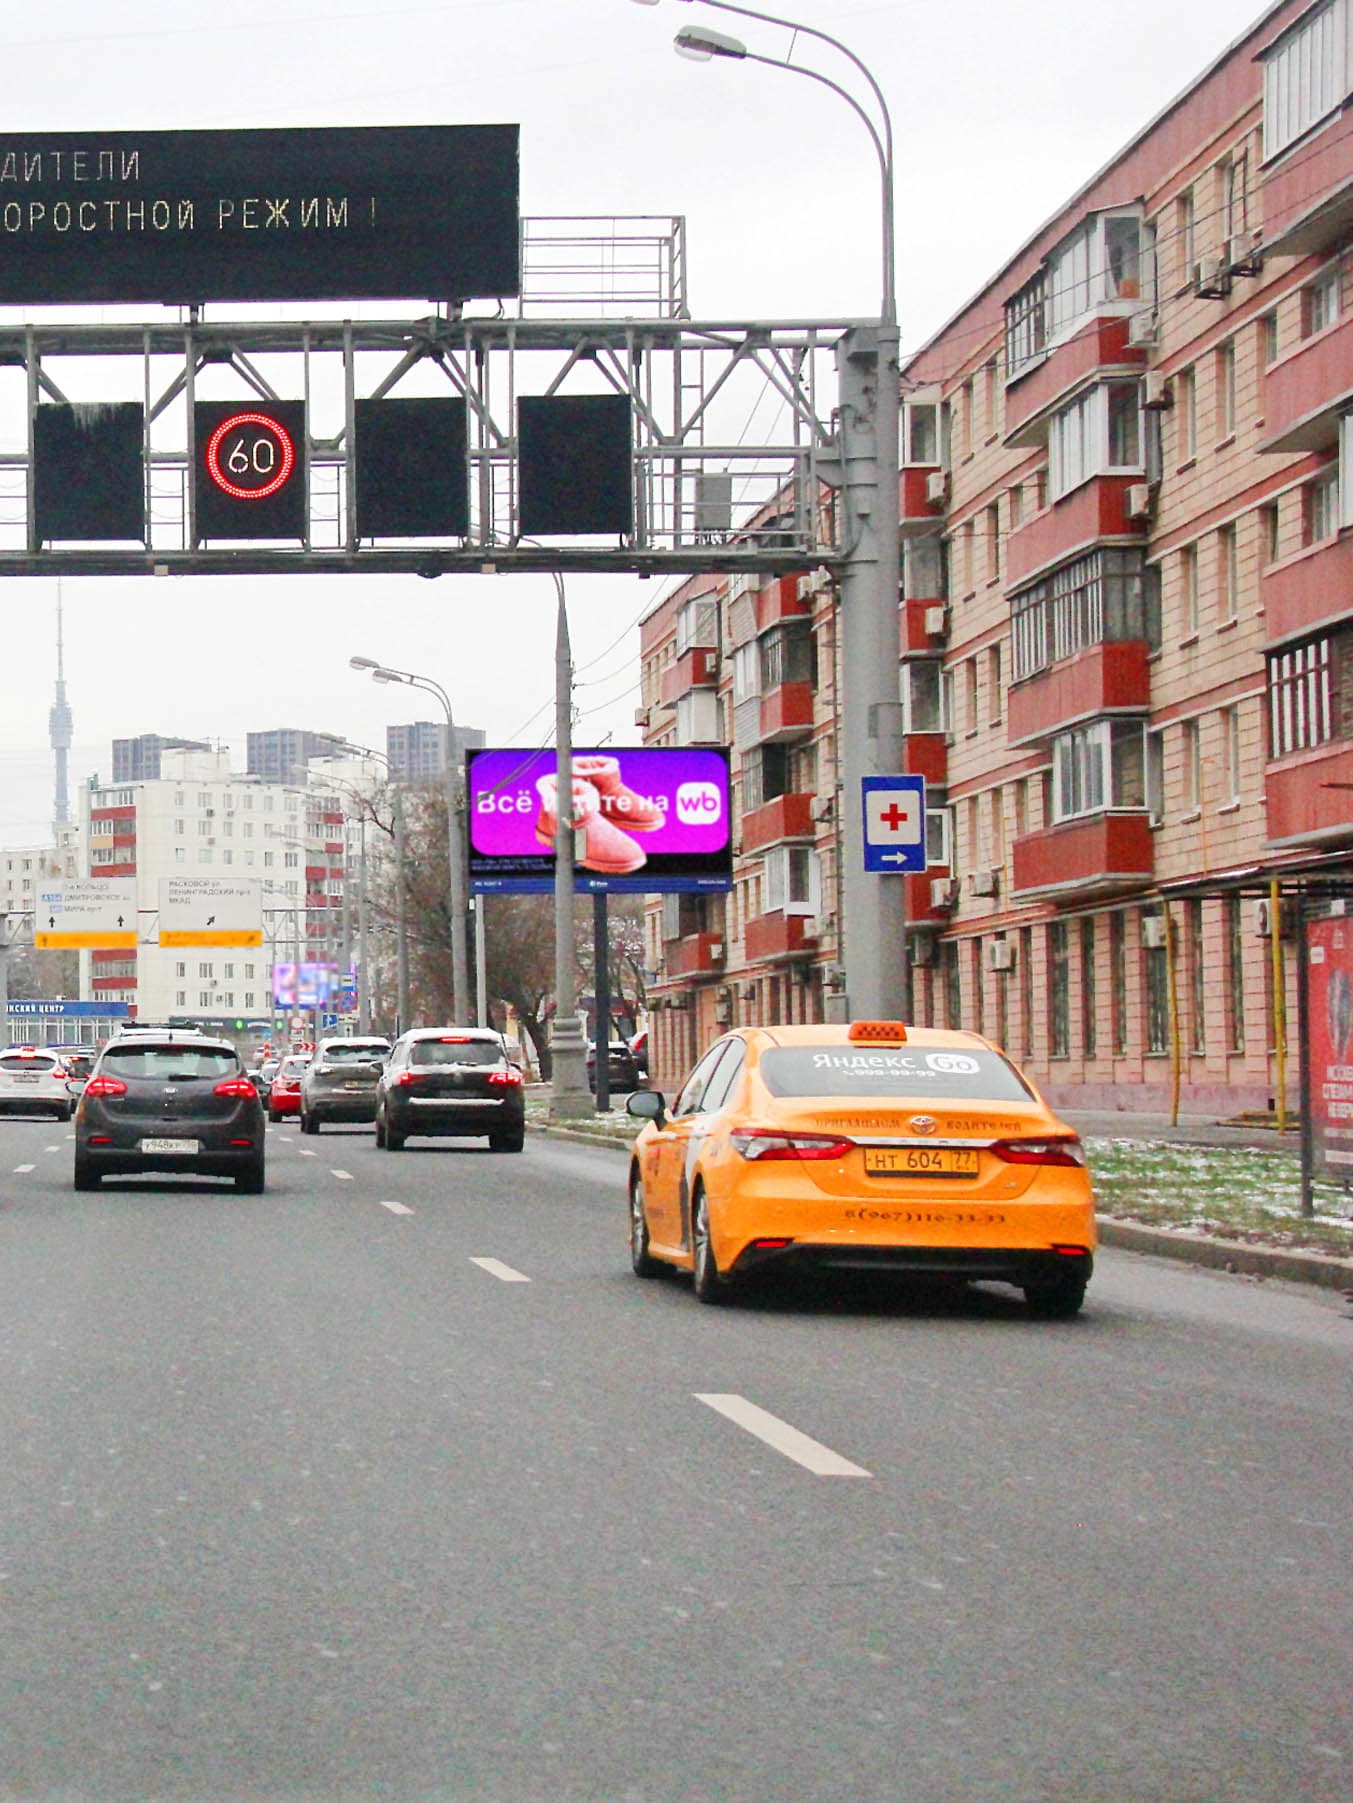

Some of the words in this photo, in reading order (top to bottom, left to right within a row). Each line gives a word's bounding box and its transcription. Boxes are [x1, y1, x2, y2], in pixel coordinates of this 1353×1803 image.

[218, 197, 348, 230] РЕЖИМ
[229, 439, 274, 473] 60
[477, 790, 533, 813] Всё
[638, 795, 669, 812] на
[680, 791, 718, 810] wb
[38, 1003, 65, 1014] ЦЕНТР
[812, 1053, 917, 1069] Яндекс
[874, 1154, 899, 1169] НТ
[906, 1153, 944, 1169] 604
[952, 1150, 972, 1165] 77
